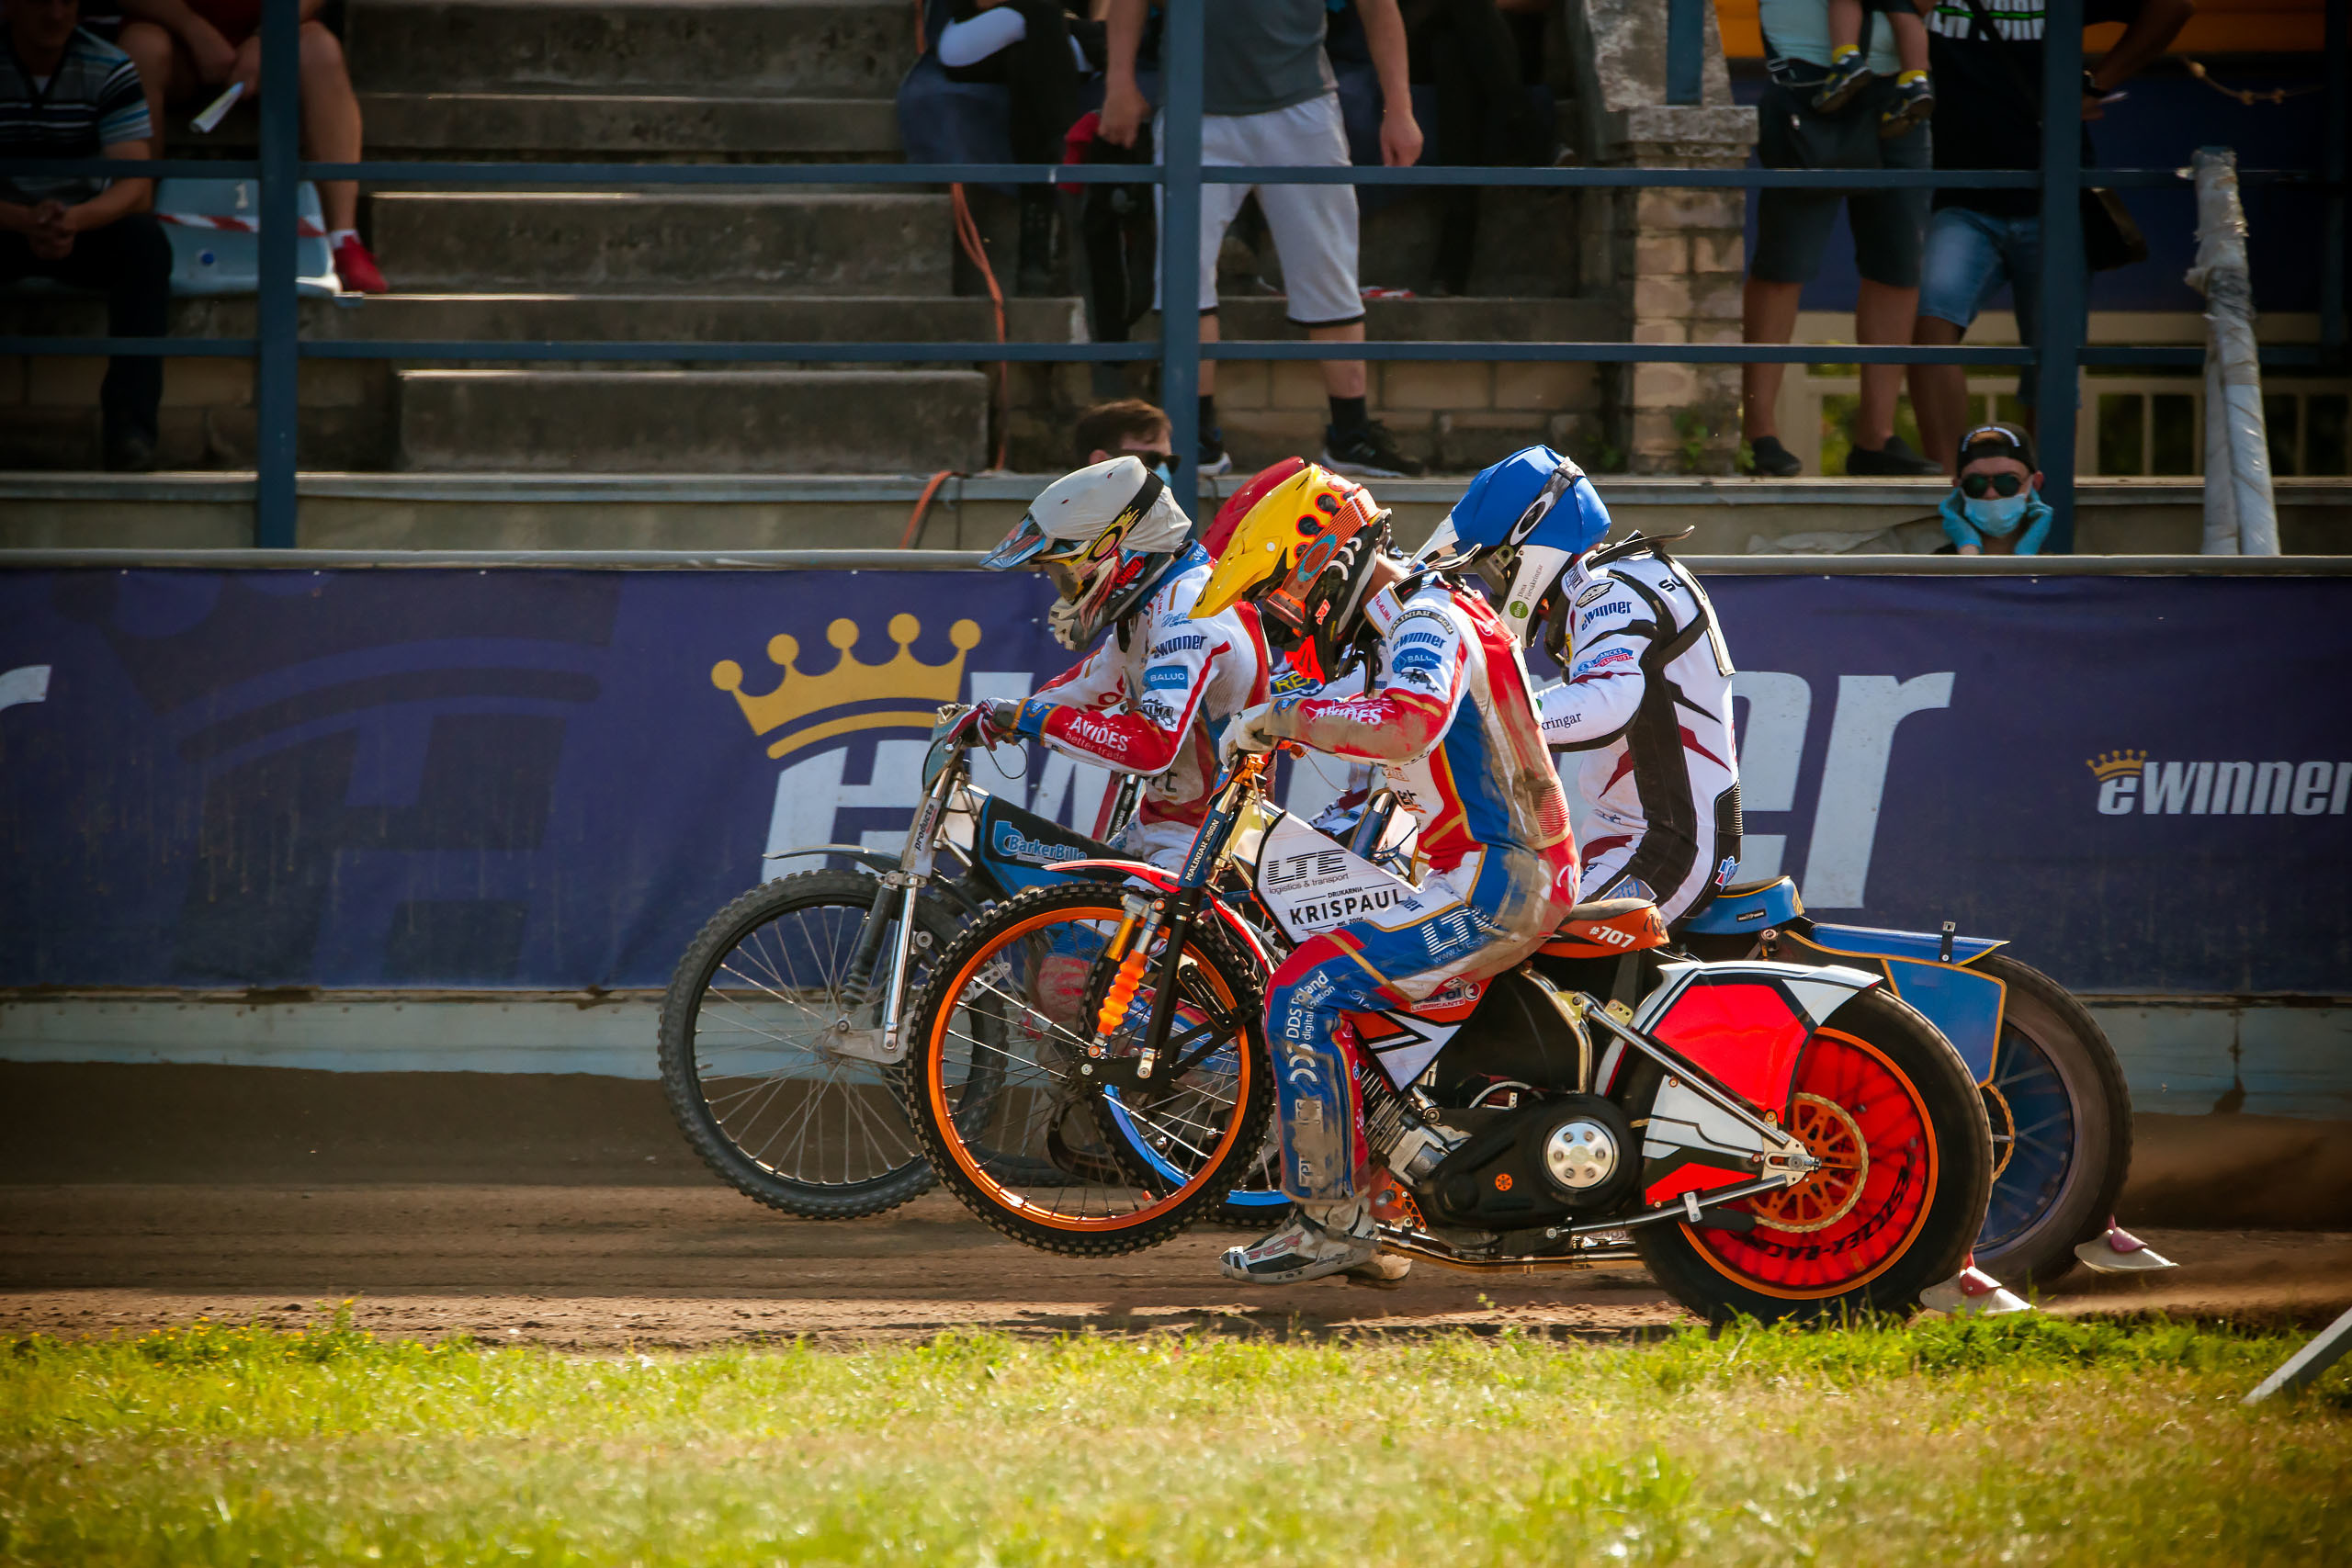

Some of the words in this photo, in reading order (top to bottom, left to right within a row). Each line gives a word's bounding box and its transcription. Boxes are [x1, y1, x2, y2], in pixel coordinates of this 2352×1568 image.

[1066, 730, 1095, 750] better
[1098, 747, 1125, 761] trade
[1069, 716, 1128, 752] AVIDES
[915, 803, 935, 852] products
[1009, 834, 1087, 860] BarkerBille
[1267, 850, 1347, 886] LTE
[1269, 883, 1302, 896] logistics
[1304, 879, 1310, 888] &
[1312, 874, 1349, 887] transport
[1328, 886, 1363, 898] DRUKARNIA
[1289, 888, 1405, 926] KRISPAUL
[1286, 1009, 1303, 1039] DDS
[1302, 1010, 1315, 1041] digital
